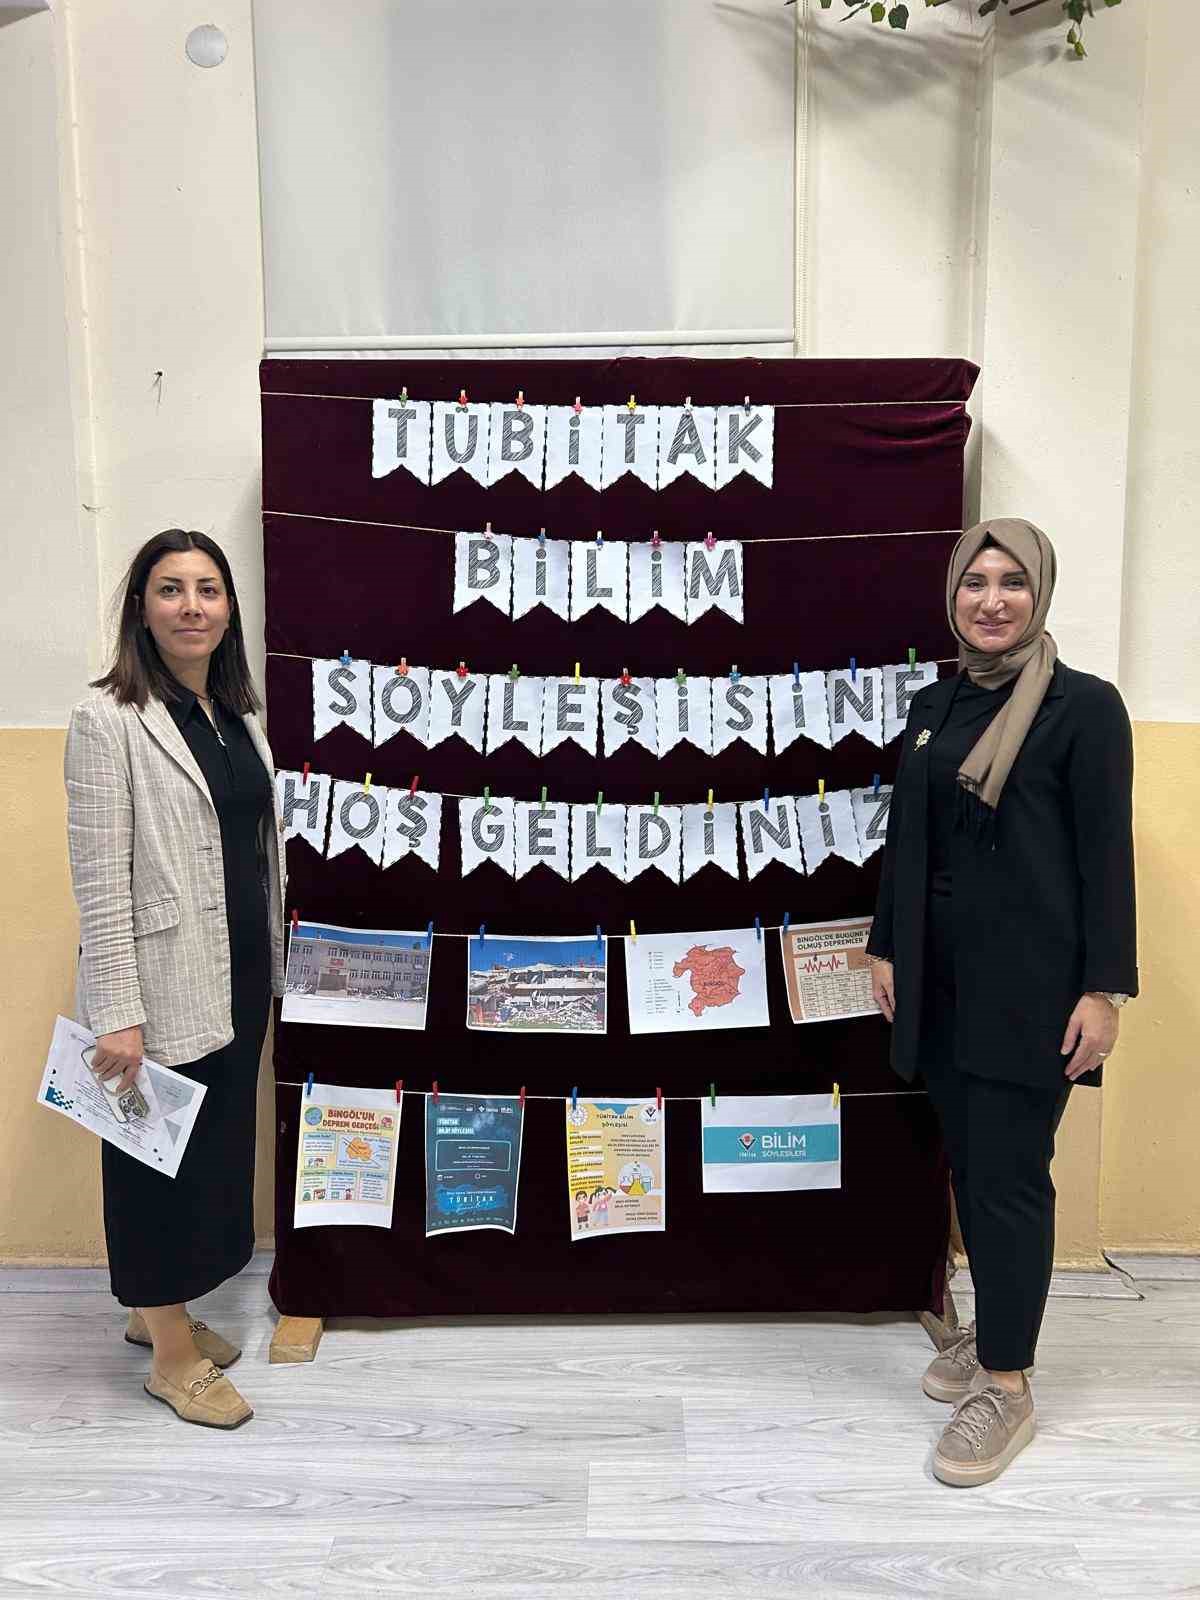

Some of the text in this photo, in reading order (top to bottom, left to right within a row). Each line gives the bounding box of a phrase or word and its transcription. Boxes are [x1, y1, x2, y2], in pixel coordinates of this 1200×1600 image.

[388, 407, 763, 465] TÜBİTAK
[467, 539, 740, 599] BİLİM
[283, 778, 428, 848] HOŞ
[471, 792, 892, 859] GELDİNİZ
[761, 1132, 807, 1149] BİLİM
